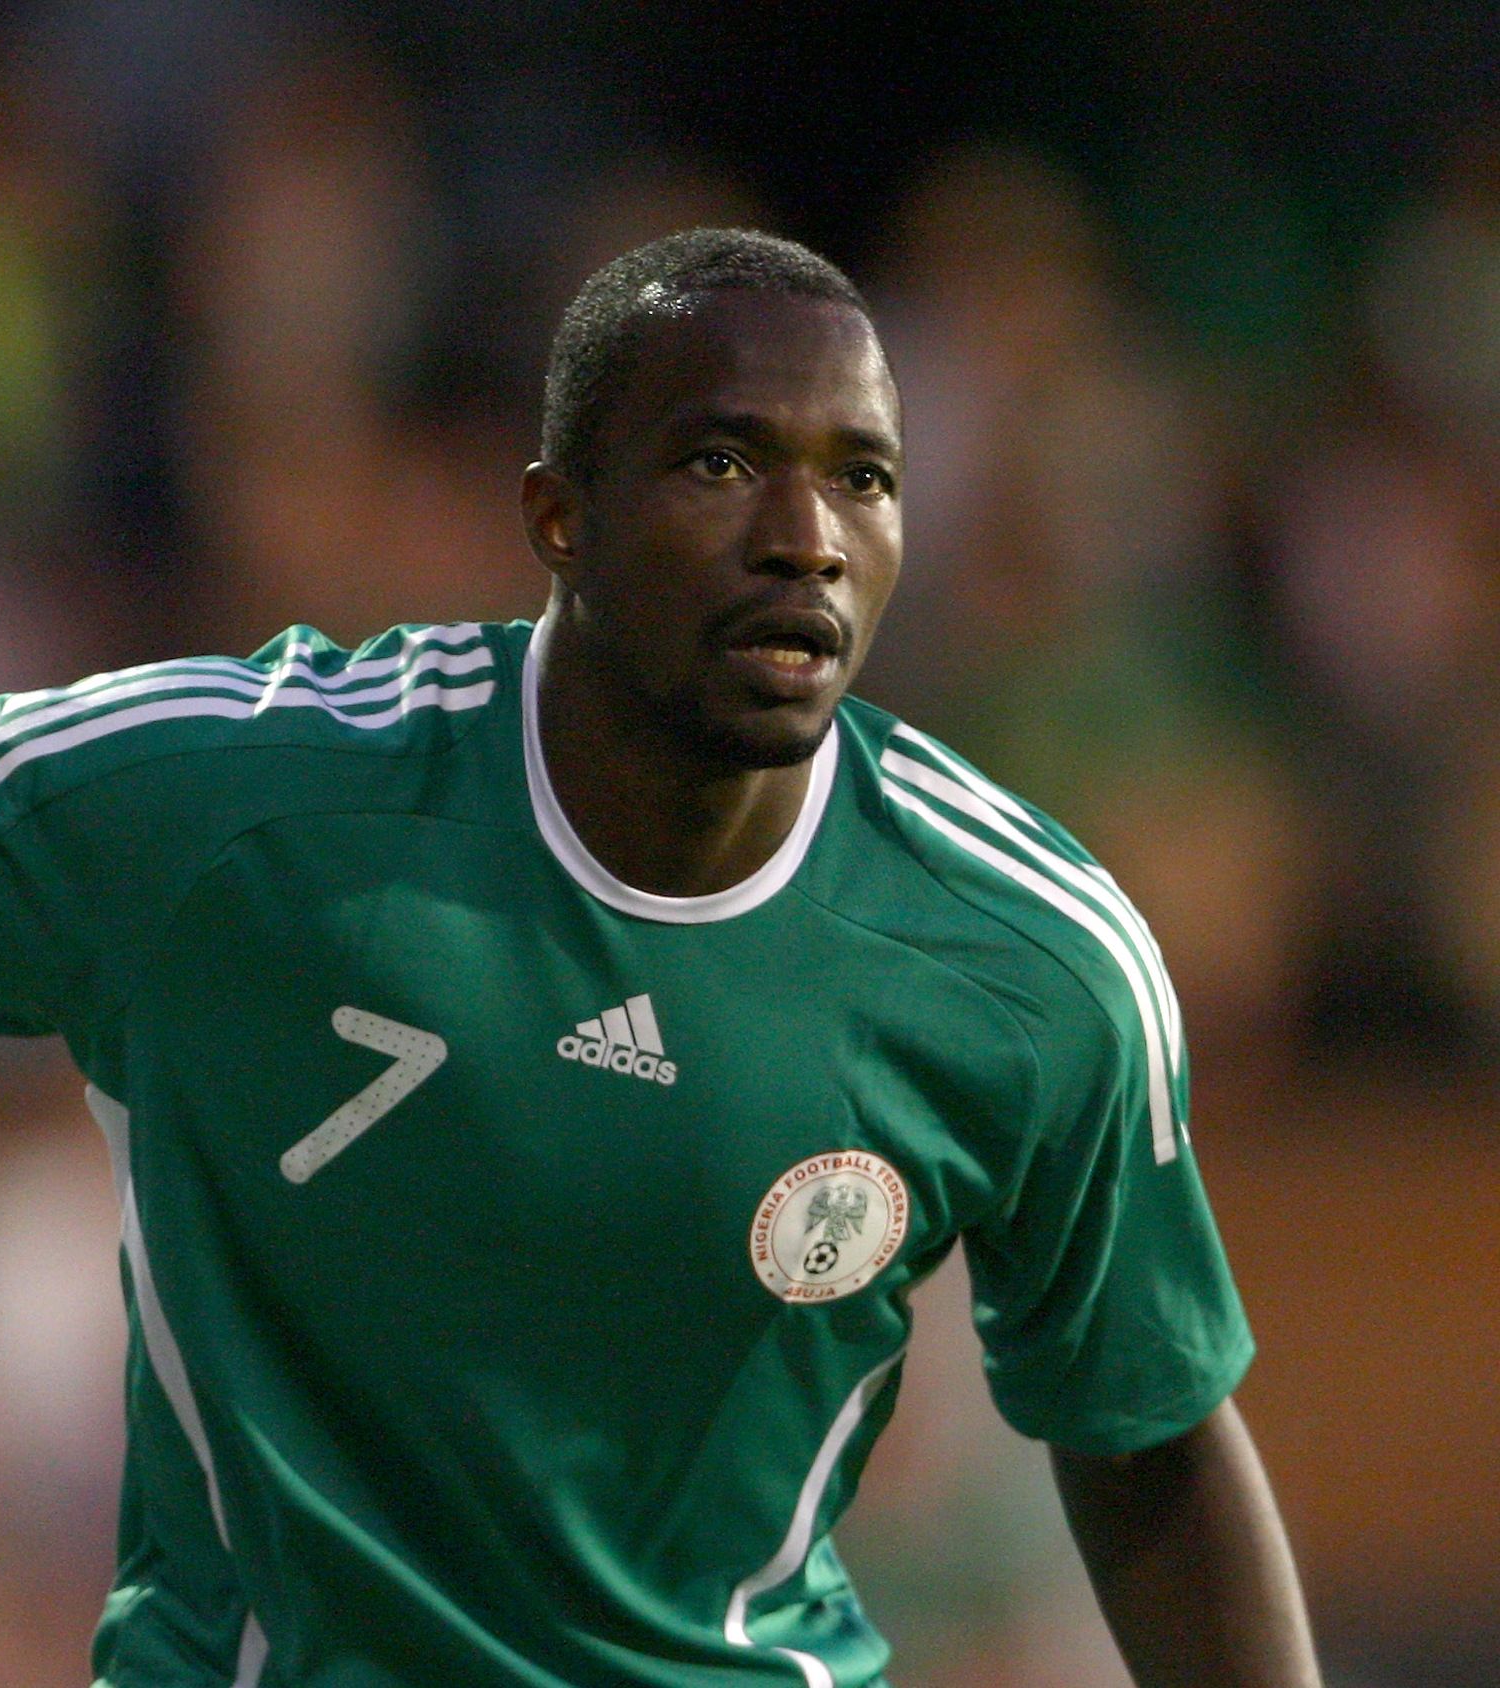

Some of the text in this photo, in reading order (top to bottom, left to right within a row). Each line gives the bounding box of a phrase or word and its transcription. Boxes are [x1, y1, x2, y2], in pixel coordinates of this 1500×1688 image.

[279, 1005, 448, 1184] 7
[556, 1035, 677, 1085] adidas
[755, 1155, 905, 1267] NIGERIA FOOTBALL FEDERATION
